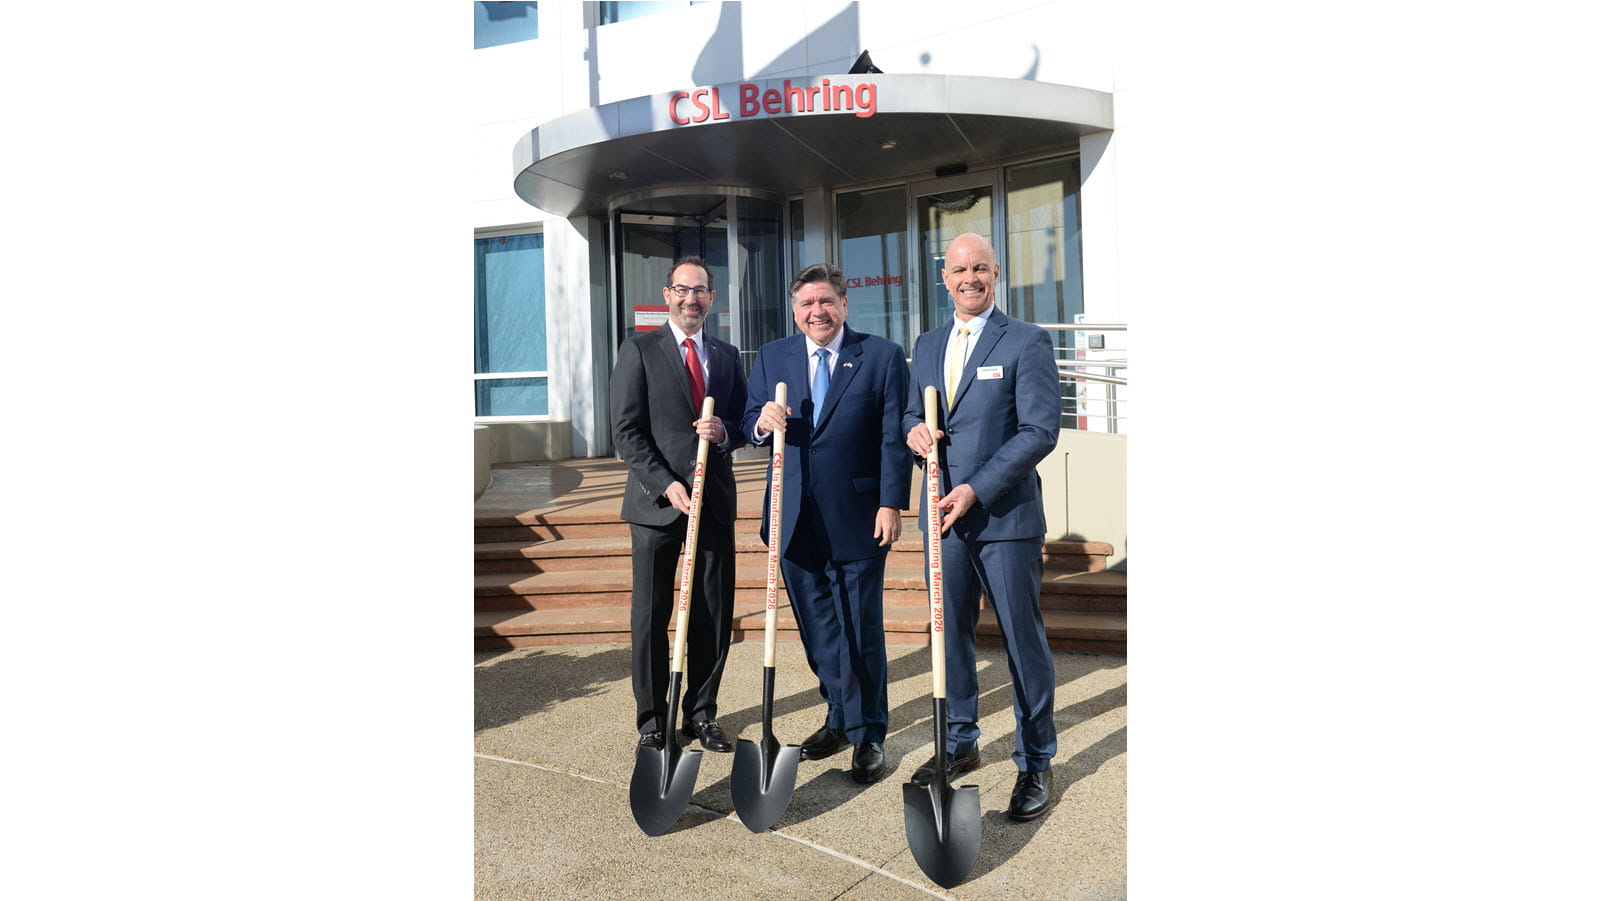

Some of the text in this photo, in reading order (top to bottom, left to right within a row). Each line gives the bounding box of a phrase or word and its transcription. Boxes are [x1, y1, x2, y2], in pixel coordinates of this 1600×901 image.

[669, 78, 877, 125] CSL Behring
[846, 274, 903, 288] CSL Behring
[694, 461, 704, 479] CSL
[773, 452, 783, 471] CSL
[929, 461, 939, 481] CSL
[684, 491, 700, 556] Manufacturing
[769, 484, 781, 552] Manufacturing
[930, 495, 940, 569] Manufacturing
[682, 558, 692, 587] March
[768, 554, 779, 584] March
[679, 589, 689, 612] 2026
[767, 587, 777, 610] 2026
[932, 571, 942, 604] March
[934, 607, 944, 633] 2026
